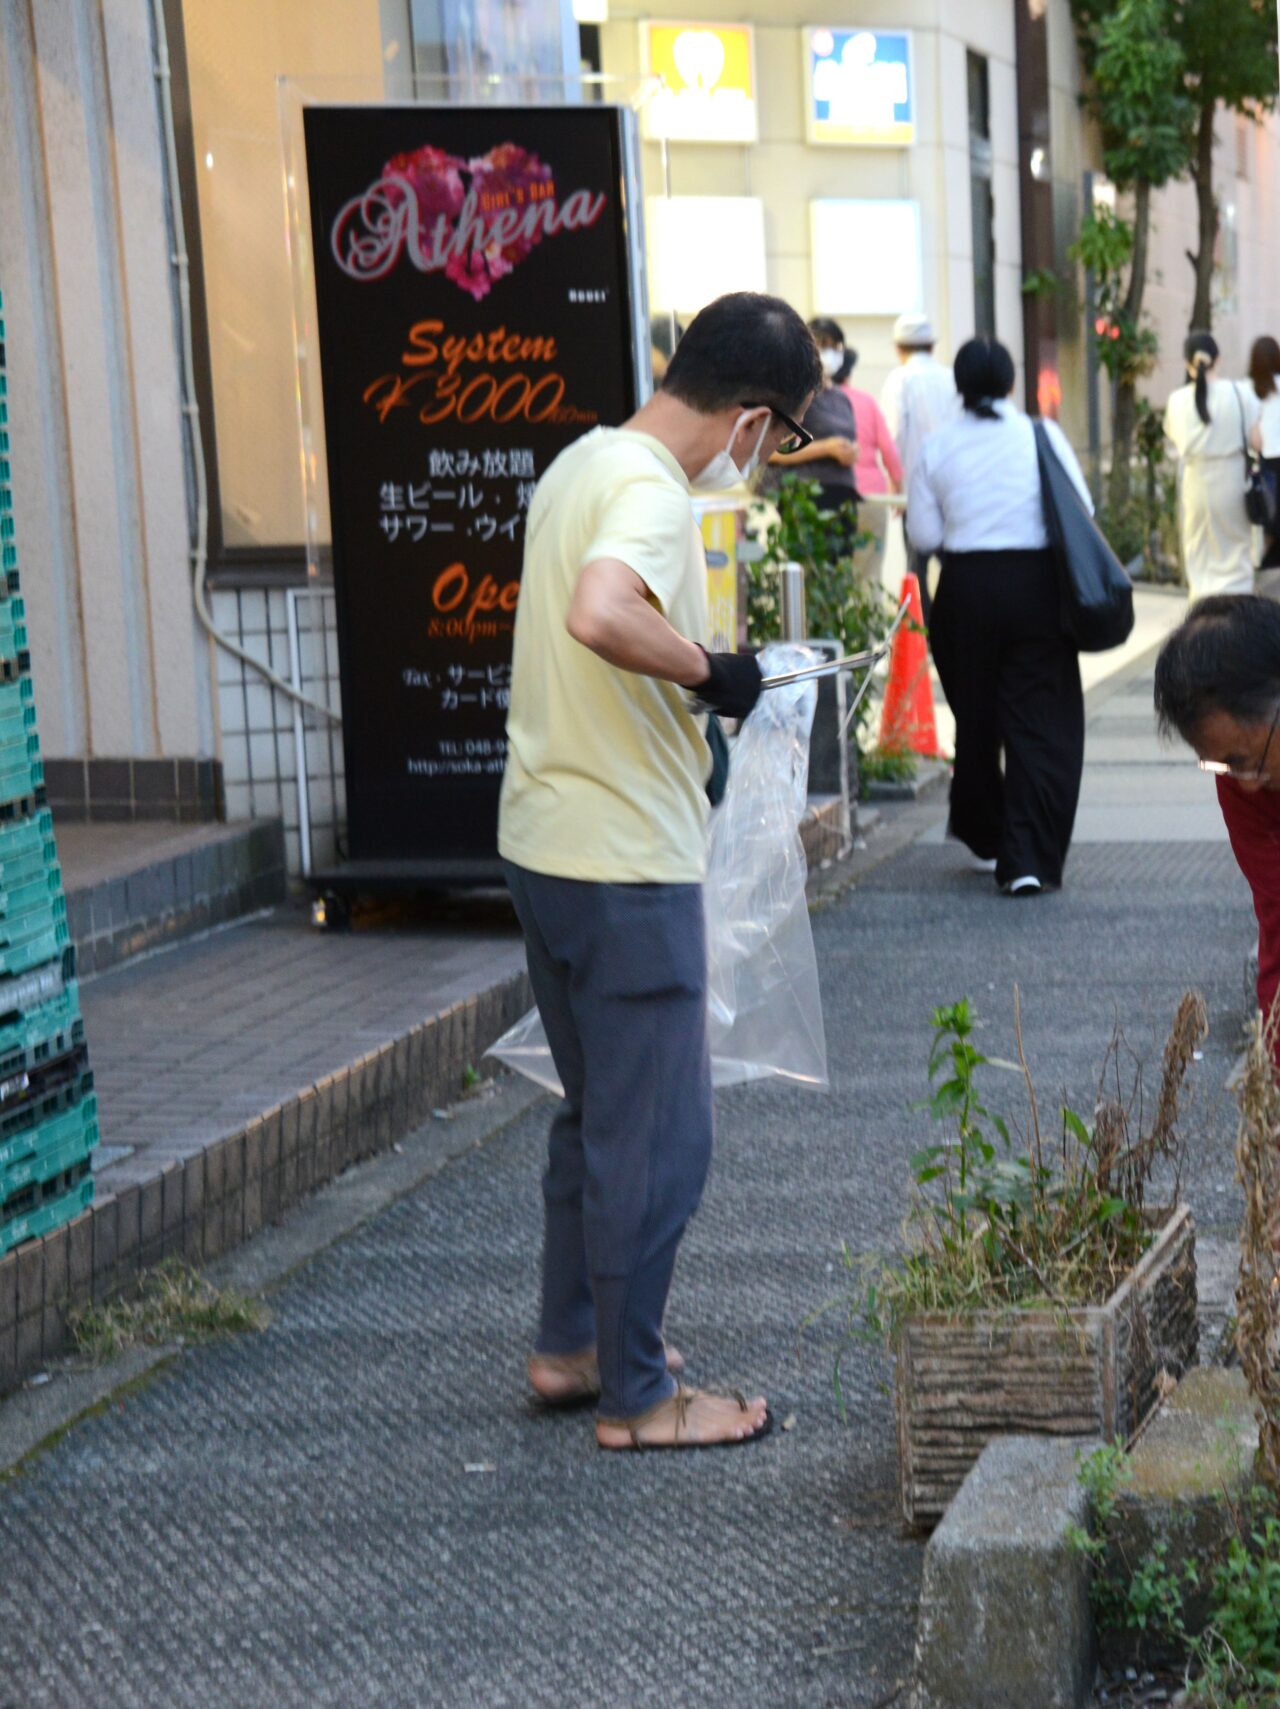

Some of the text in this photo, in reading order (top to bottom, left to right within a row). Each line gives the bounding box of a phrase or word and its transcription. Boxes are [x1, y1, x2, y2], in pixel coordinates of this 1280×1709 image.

[331, 177, 606, 281] Athena
[402, 319, 556, 376] System
[429, 448, 535, 478] 飲み放題
